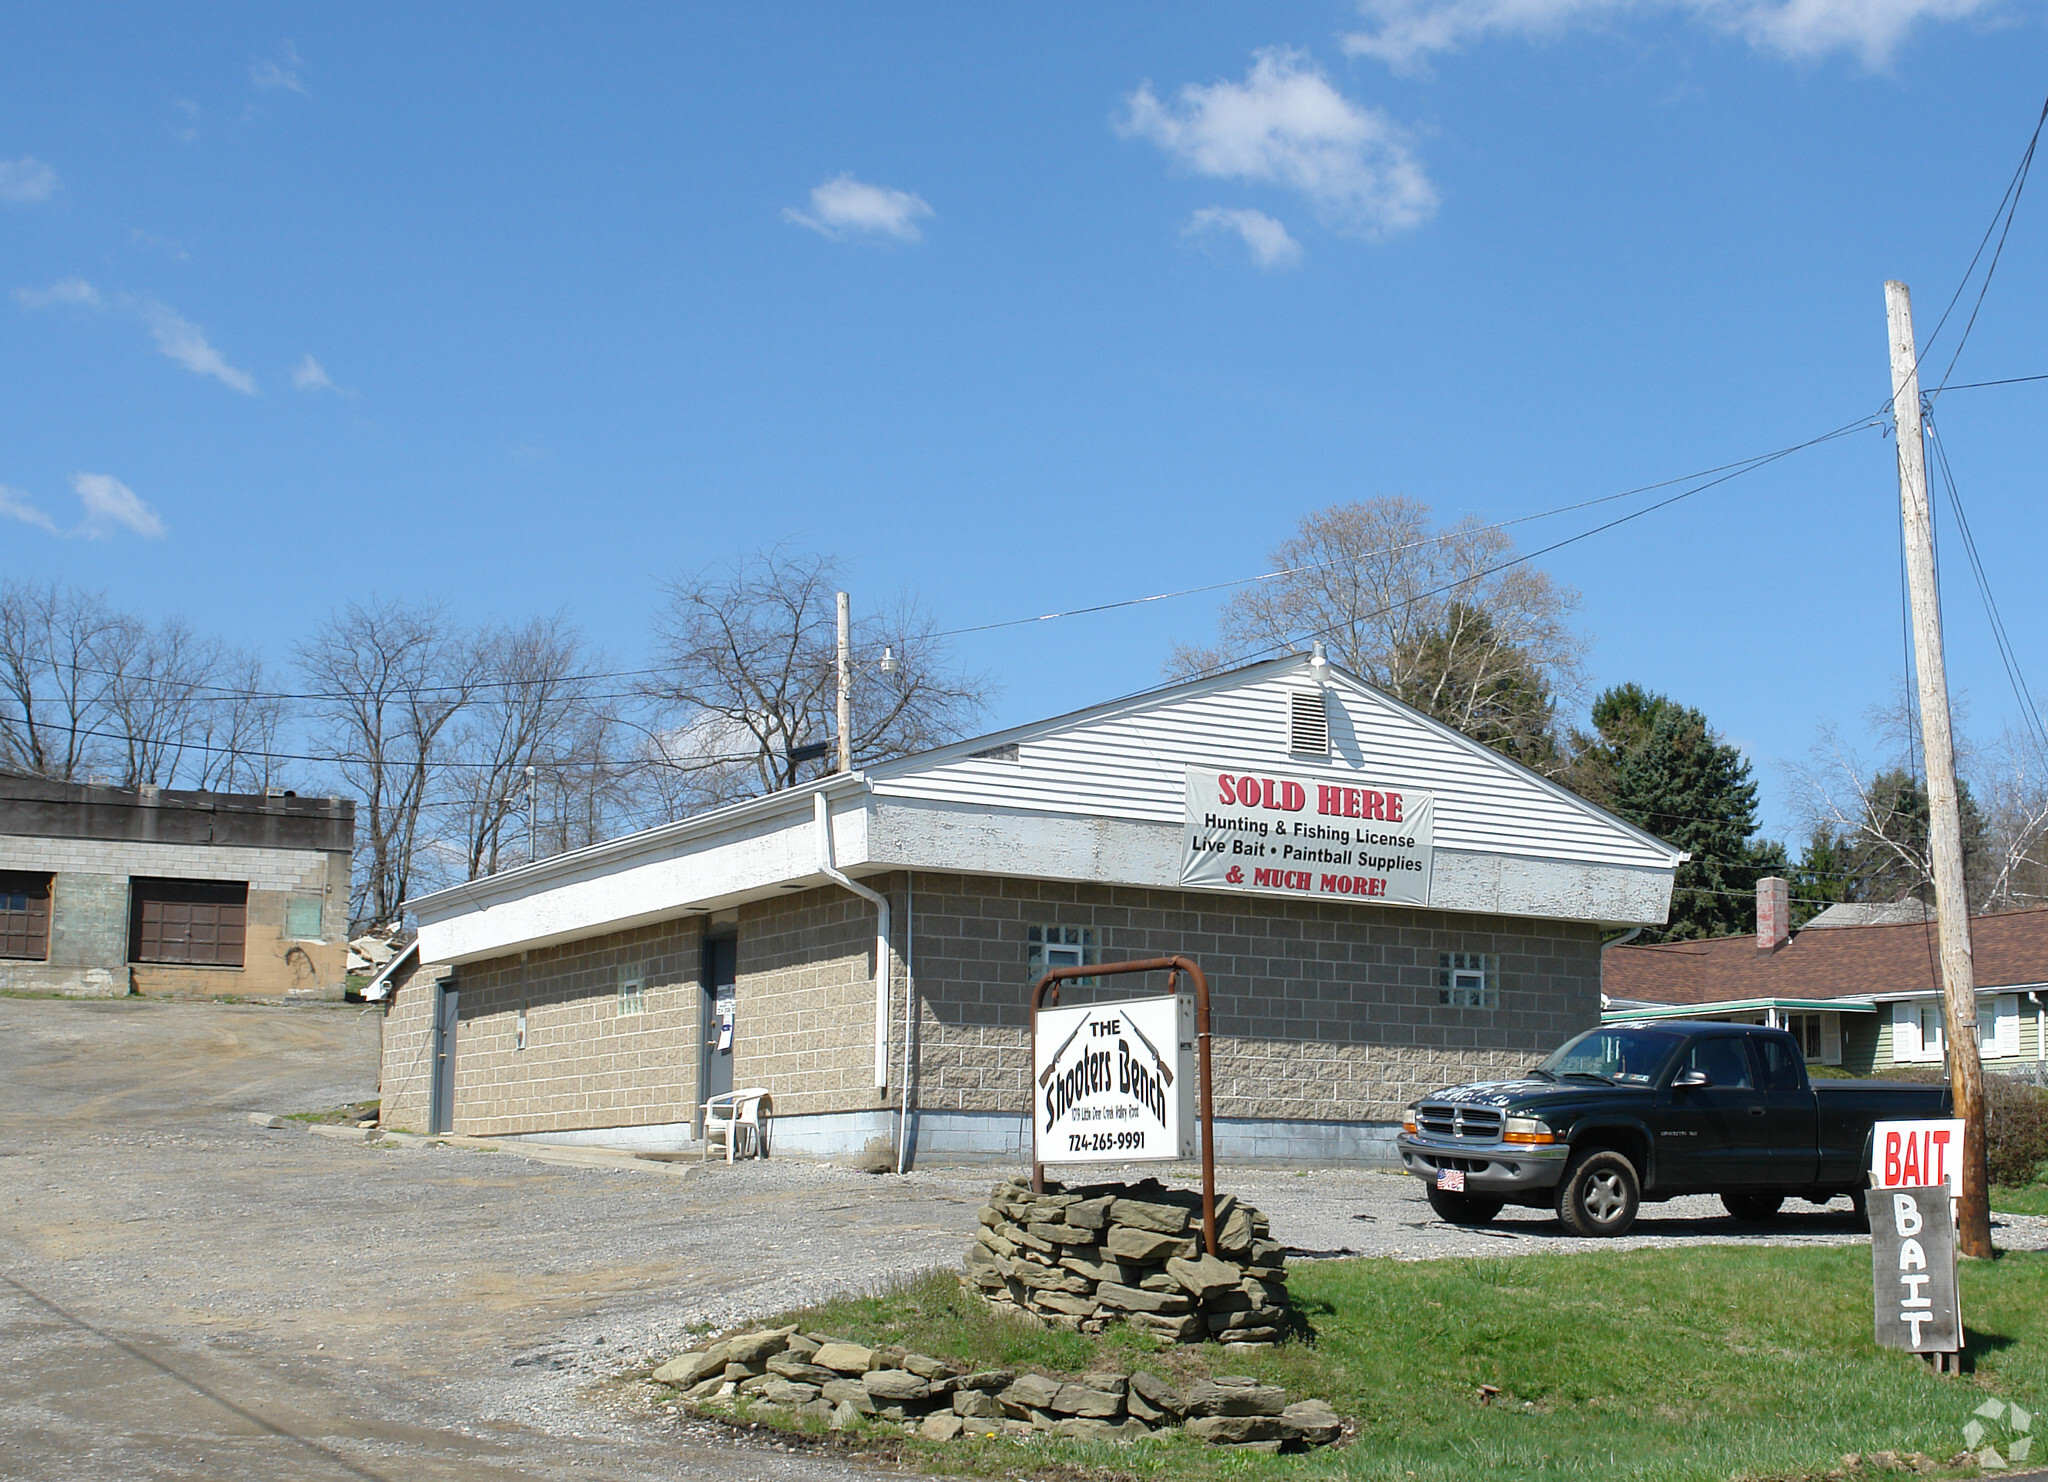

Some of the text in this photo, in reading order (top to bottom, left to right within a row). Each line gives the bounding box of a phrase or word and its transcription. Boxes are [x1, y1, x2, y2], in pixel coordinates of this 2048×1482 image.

[1218, 774, 1403, 822] SOLD HERE
[1205, 813, 1415, 848] Hunting & Fishing License
[1192, 836, 1422, 872] Live Bait Paintball Supplies
[1225, 865, 1387, 897] & MUCH MORE!
[1089, 1019, 1121, 1037] THE
[1046, 1038, 1166, 1134] Shooters Bench
[1069, 1131, 1145, 1151] 724-265-9991
[1885, 1130, 1950, 1186] BAIT
[1893, 1193, 1933, 1348] BAIT
